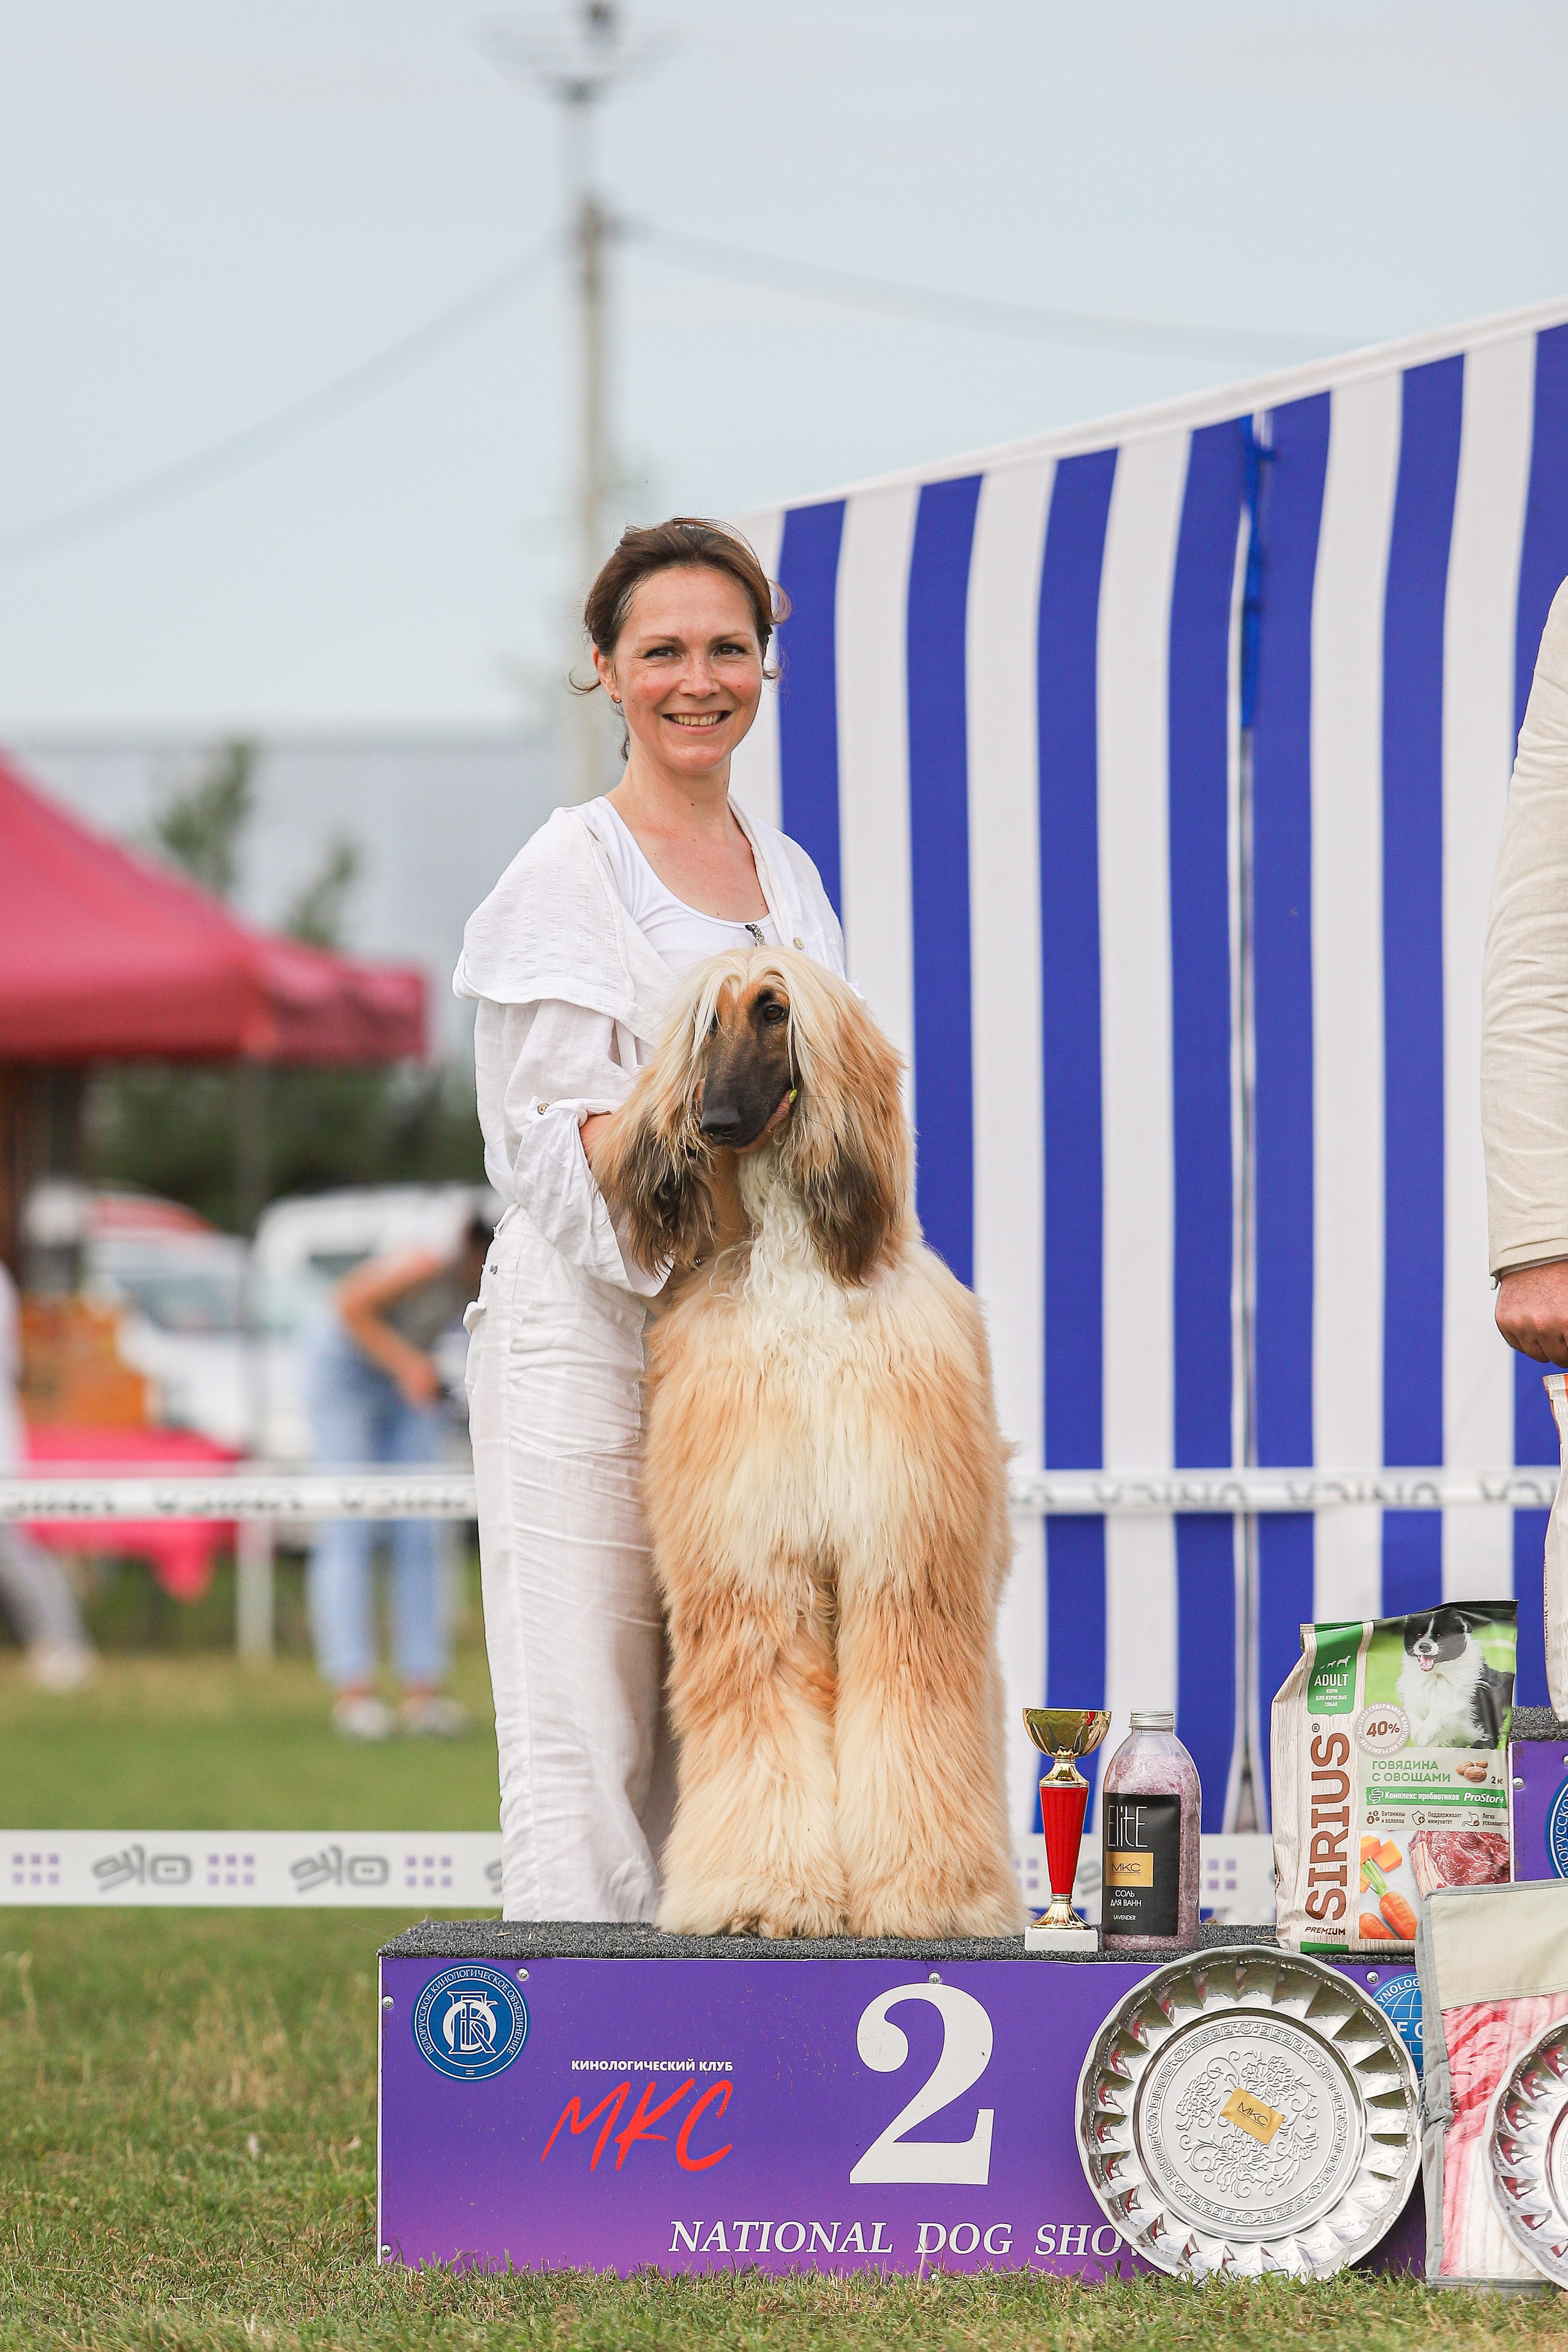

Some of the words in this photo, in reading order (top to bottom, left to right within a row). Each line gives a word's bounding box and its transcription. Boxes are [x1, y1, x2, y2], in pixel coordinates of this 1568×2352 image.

[1314, 1673, 1349, 1687] ADULT
[1357, 1710, 1370, 1735] ВЫСОКОЕ
[1368, 1703, 1404, 1716] СОДЕРЖАНИЕ
[1366, 1721, 1400, 1738] 40%
[1372, 1760, 1439, 1770] ГОВЯДИНА
[1371, 1773, 1381, 1782] С
[1384, 1773, 1450, 1782] ОВОЩАМИ
[1418, 1791, 1460, 1801] пробиотиков
[1463, 1792, 1504, 1804] ProStor+
[1110, 1899, 1122, 1907] ДЛЯ
[1305, 1925, 1346, 1936] PREMIUM
[418, 1992, 435, 2055] БЕЛОРУССКОЕ
[432, 1969, 510, 1992] КИНОЛОГИЧЕСКОЕ
[506, 1989, 524, 2056] ОБЪЕДИНЕНИЕ
[571, 2058, 696, 2072] КИНОЛОГИЧЕСКИЙ
[699, 2060, 734, 2073] КЛУБ
[849, 1982, 994, 2185] 2
[668, 2220, 894, 2255] NATIONAL
[913, 2222, 1014, 2256] DOG
[1035, 2223, 1137, 2256] SHO
